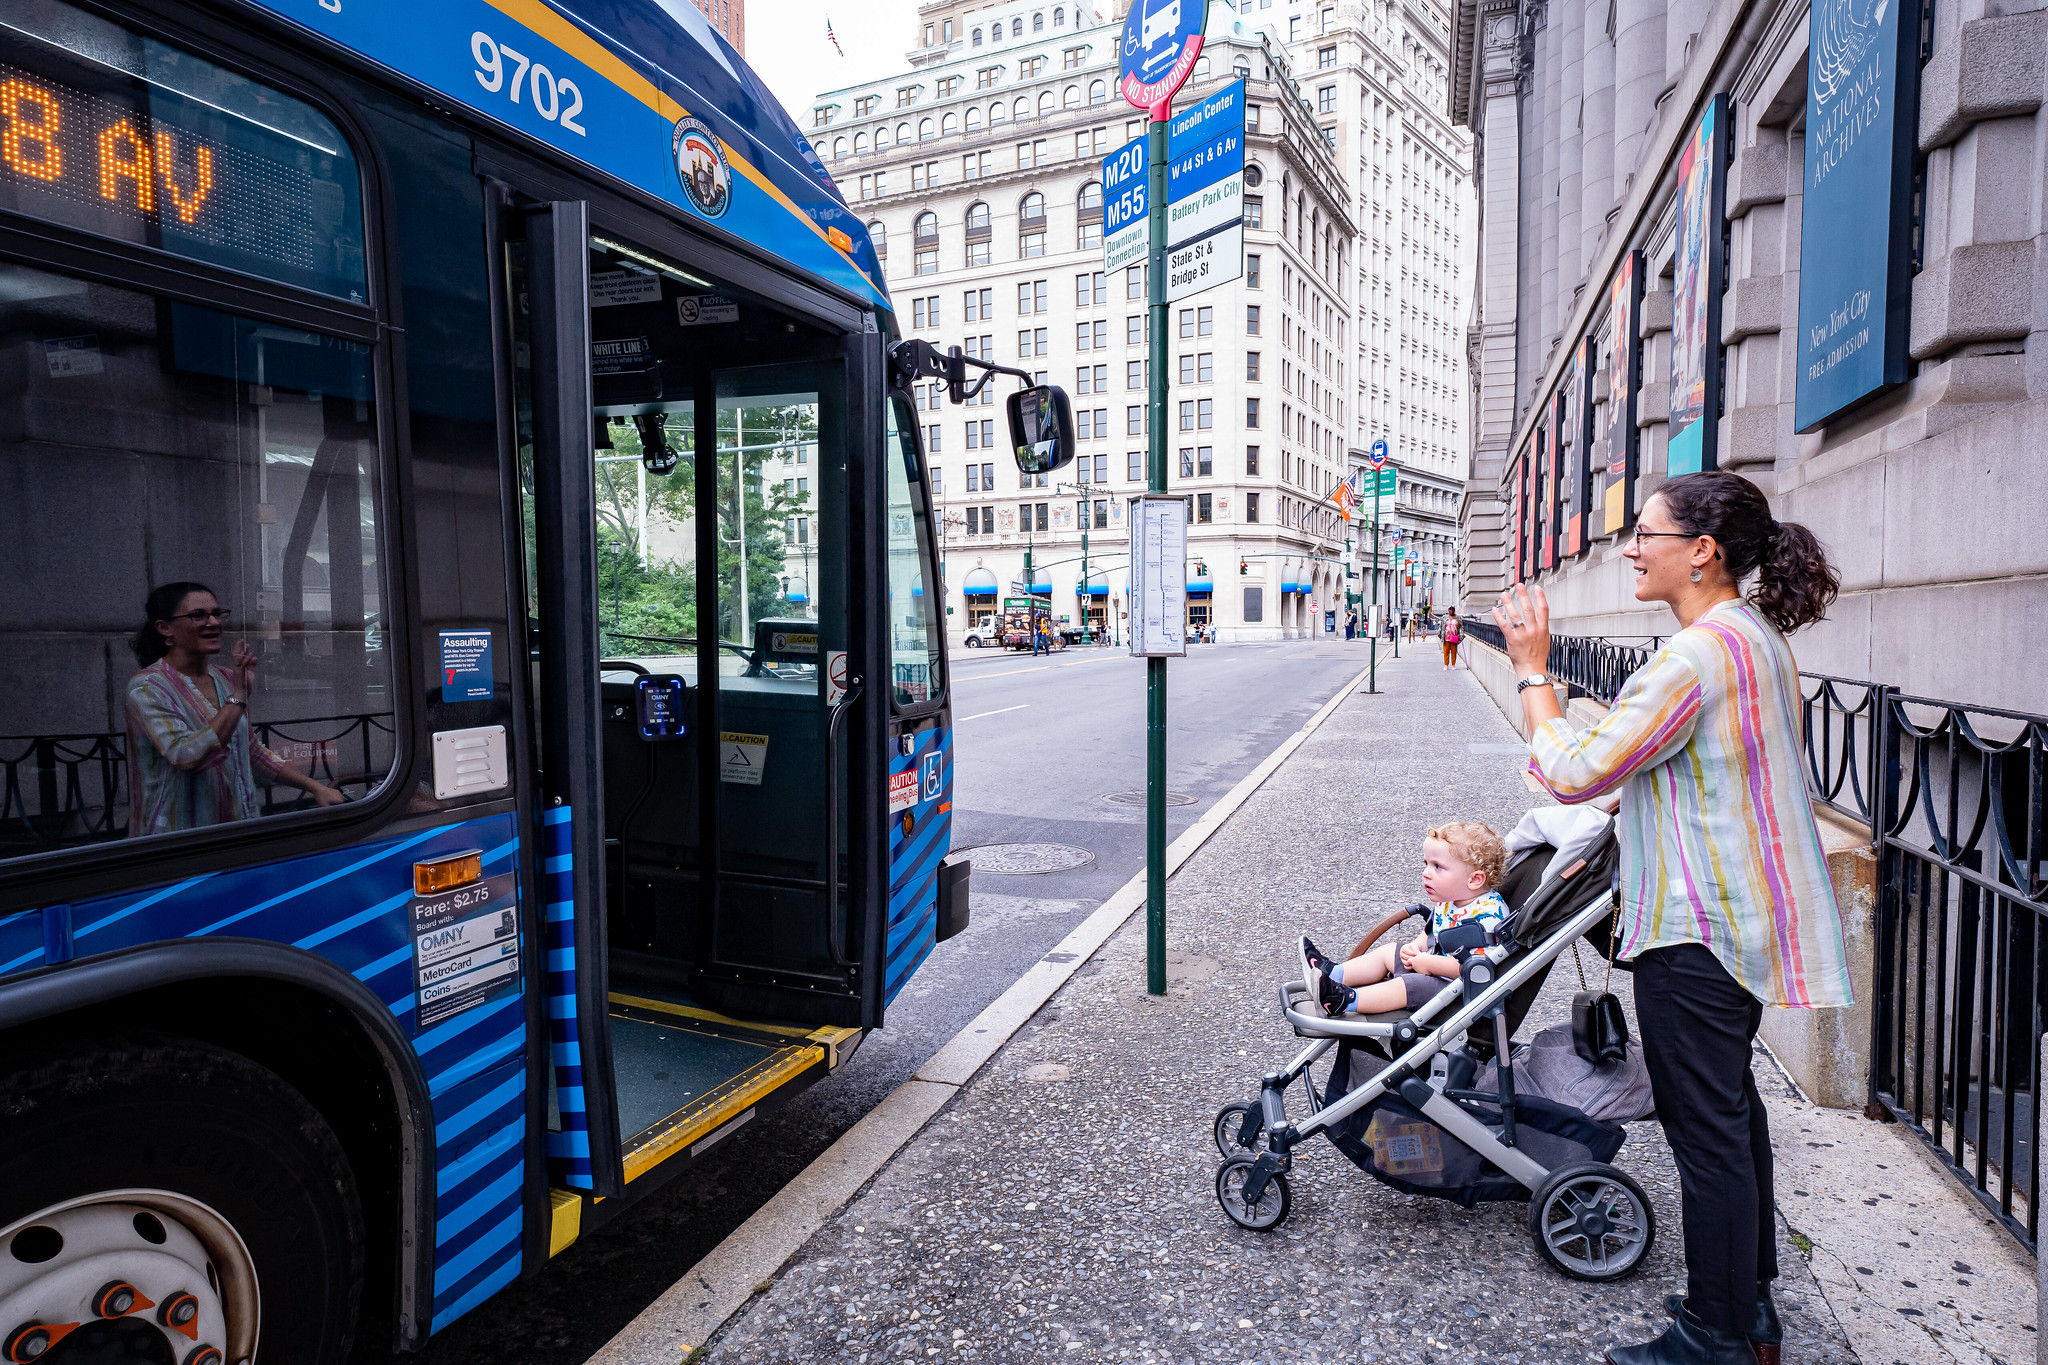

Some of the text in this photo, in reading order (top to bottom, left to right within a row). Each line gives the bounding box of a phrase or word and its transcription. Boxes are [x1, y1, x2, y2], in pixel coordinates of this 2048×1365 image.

[471, 31, 586, 137] 9702
[1126, 48, 1194, 102] NO STANDING
[1173, 94, 1234, 137] Lincoln Center
[1816, 52, 1881, 154] NATIONAL
[673, 119, 692, 141] QUALITY
[1814, 86, 1880, 188] ARCHIVES
[100, 118, 211, 223] AV
[1106, 144, 1142, 190] M20
[1172, 137, 1236, 179] W 44 St & 6 Av
[682, 174, 726, 214] MANHATTAN DIVISION
[1108, 184, 1144, 228] M55
[1172, 181, 1240, 222] Battery Park City
[1107, 228, 1142, 254] Downtown
[1107, 242, 1146, 268] Connection
[1172, 241, 1213, 269] State St &
[1172, 262, 1209, 287] Bridge St
[703, 297, 732, 305] NOTIC
[1810, 290, 1871, 352] New York City
[594, 341, 642, 355] WHITE LINE
[1809, 327, 1869, 382] FREE ADMISSION
[444, 638, 487, 648] Assaulting
[445, 669, 455, 684] 7
[294, 743, 316, 751] FIRE
[729, 735, 765, 744] CAUTION
[294, 749, 337, 757] EQUIPM
[889, 770, 918, 790] AUTION
[889, 789, 917, 804] neeling Bus
[415, 887, 489, 919] Fare: $2.75
[416, 916, 454, 931] Board with:
[420, 926, 464, 952] OMNY
[423, 957, 472, 982] MetroCard
[424, 985, 451, 1000] Coins
[1398, 1139, 1408, 1158] 100
[1407, 1138, 1416, 1155] first
